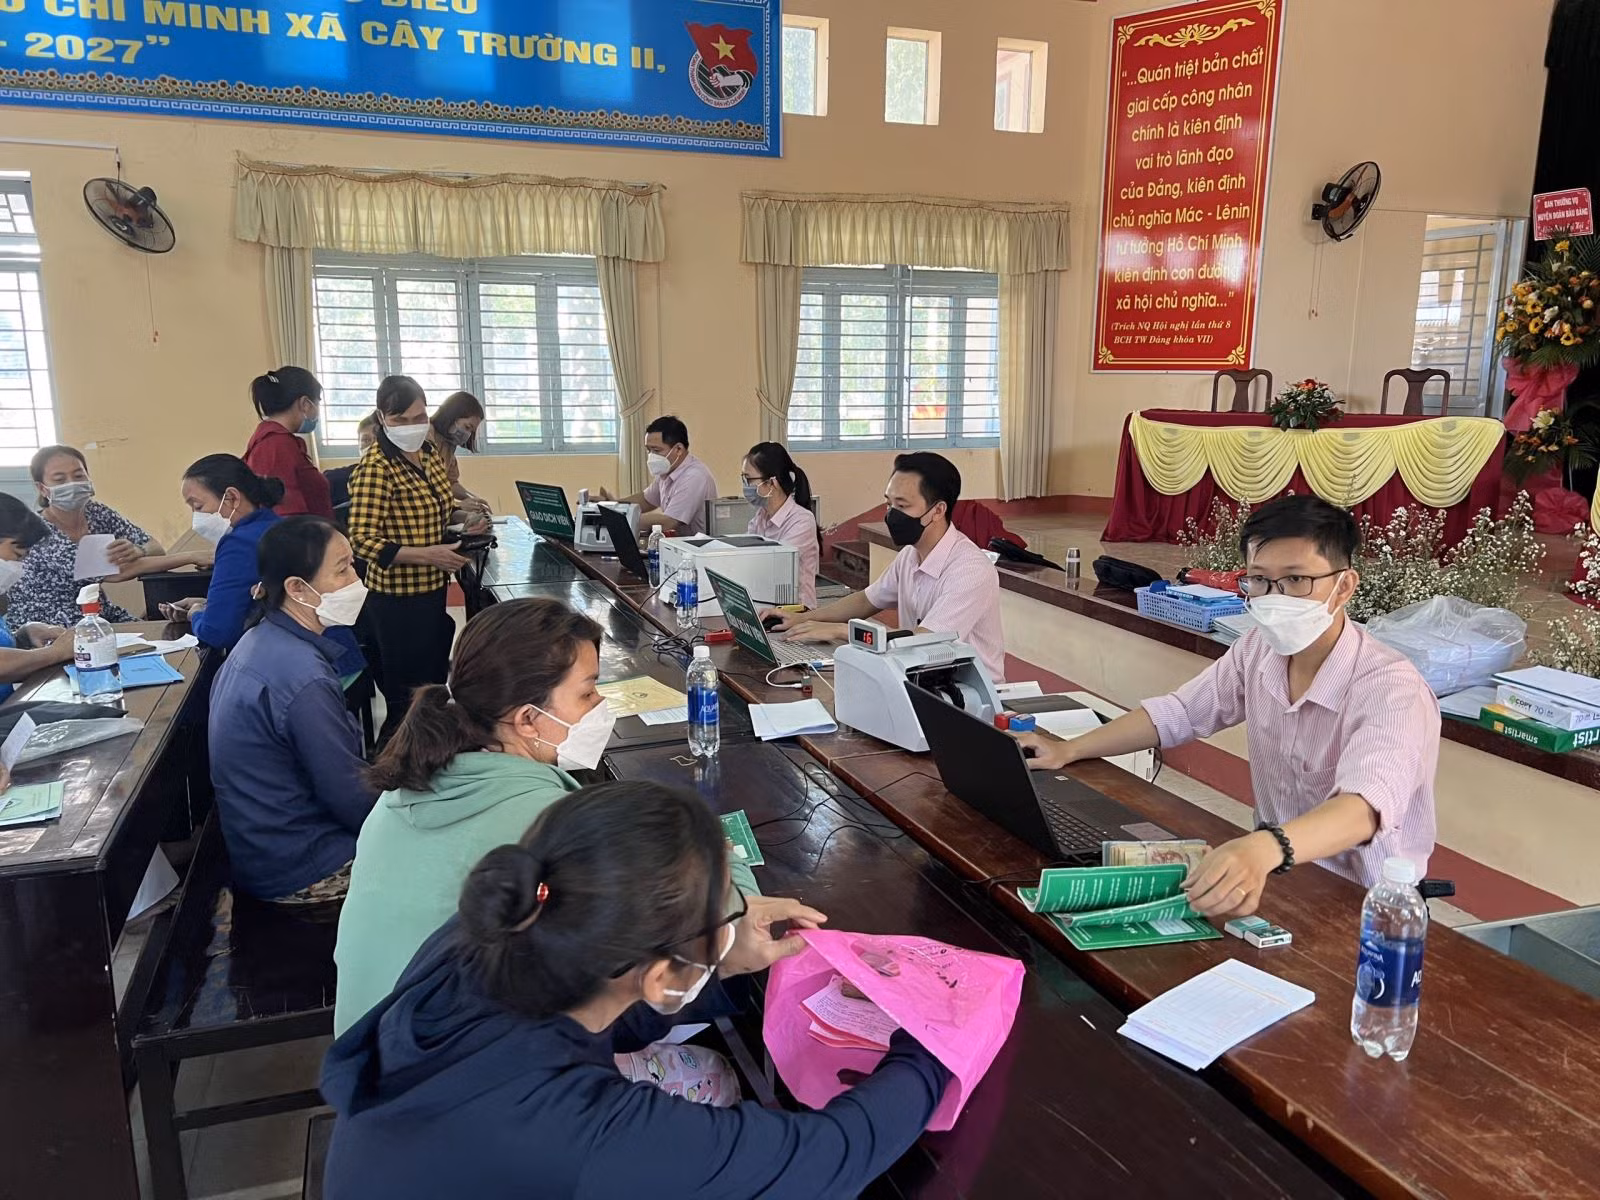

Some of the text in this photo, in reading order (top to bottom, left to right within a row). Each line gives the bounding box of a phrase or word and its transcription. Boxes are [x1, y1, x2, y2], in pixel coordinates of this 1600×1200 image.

[144, 0, 270, 34] MINH
[285, 12, 347, 41] XÃ
[361, 19, 444, 50] CÂY
[457, 29, 617, 67] TRƯỜNG
[631, 46, 666, 73] II,
[1175, 58, 1199, 80] triệt
[1202, 52, 1228, 74] bản
[1232, 45, 1264, 69] chất
[1127, 83, 1252, 118] giai cấp công nhân
[1132, 113, 1242, 143] chính là kiên định
[1135, 146, 1234, 170] vai trò lãnh đạo
[1120, 173, 1246, 201] của Đảng, kiên định
[1113, 209, 1135, 228] chủ
[1138, 211, 1172, 230] nghĩa
[1175, 206, 1203, 223] Mác
[1216, 203, 1250, 220] Lênin
[1167, 234, 1184, 253] Hồ
[1187, 234, 1209, 251] Chí
[1211, 232, 1243, 250] Minh
[1114, 267, 1139, 283] kiên
[1142, 266, 1168, 285] định
[1171, 267, 1194, 281] con
[1116, 294, 1131, 311] xã
[1134, 294, 1152, 313] hội
[1155, 290, 1178, 309] chủ
[1137, 322, 1151, 332] NQ
[1152, 321, 1167, 332] Hội
[1169, 321, 1189, 332] nghị
[1225, 320, 1231, 329] 8
[1113, 335, 1132, 344] BCH
[1134, 335, 1148, 344] TW
[863, 632, 872, 644] 16
[1515, 698, 1532, 711] COPY
[1534, 705, 1544, 715] 70
[1504, 726, 1538, 744] smartist
